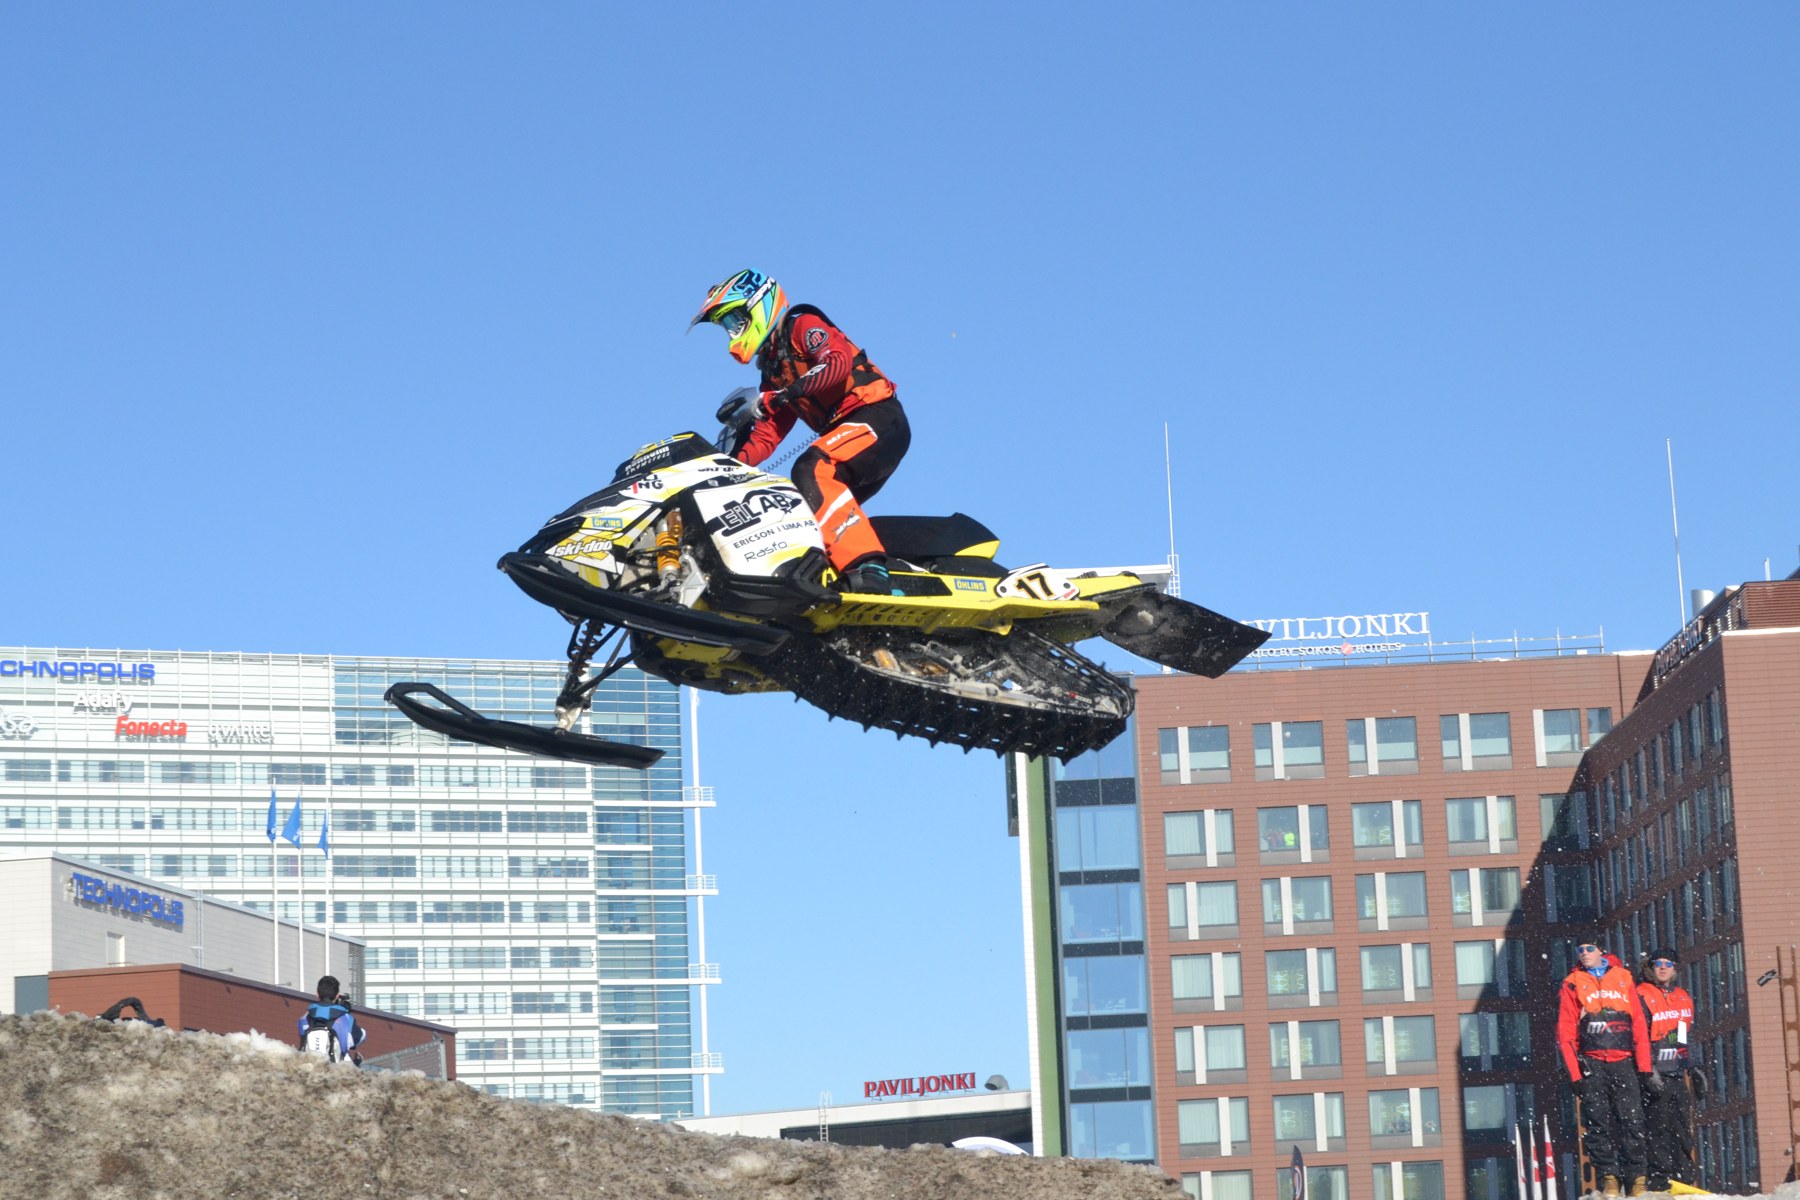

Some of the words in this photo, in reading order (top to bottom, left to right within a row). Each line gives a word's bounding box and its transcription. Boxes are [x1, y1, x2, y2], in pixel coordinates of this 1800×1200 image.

[554, 539, 613, 557] ski-doo
[733, 529, 775, 549] ERICSON
[956, 579, 986, 592] ÖHLINS
[1014, 571, 1056, 600] 17
[1241, 612, 1430, 640] VILJONKI
[115, 716, 188, 736] Fonecta
[71, 872, 185, 927] TECHNOPOLIS
[864, 1072, 976, 1097] PAVILJONKI
